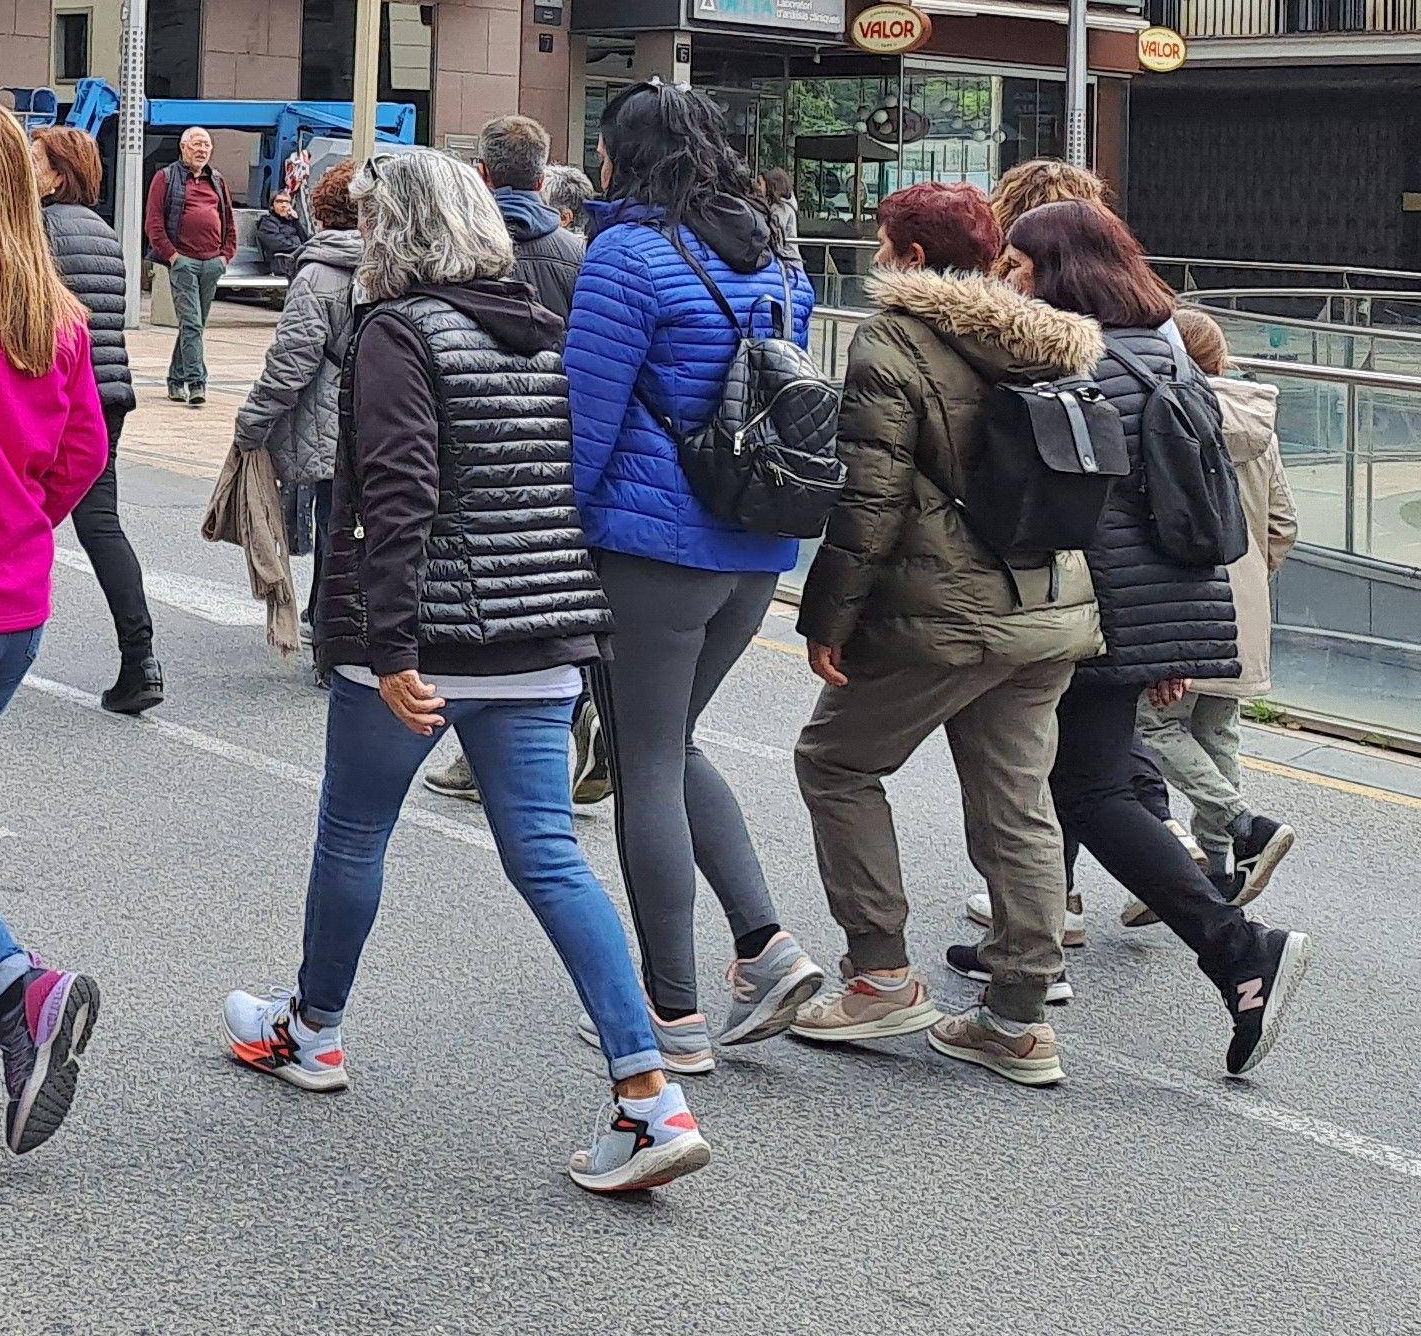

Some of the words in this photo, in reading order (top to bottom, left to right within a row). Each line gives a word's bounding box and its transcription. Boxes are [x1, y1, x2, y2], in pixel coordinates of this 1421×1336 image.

[859, 19, 915, 39] VALOR
[680, 49, 688, 62] 6
[1140, 40, 1180, 60] VALOR
